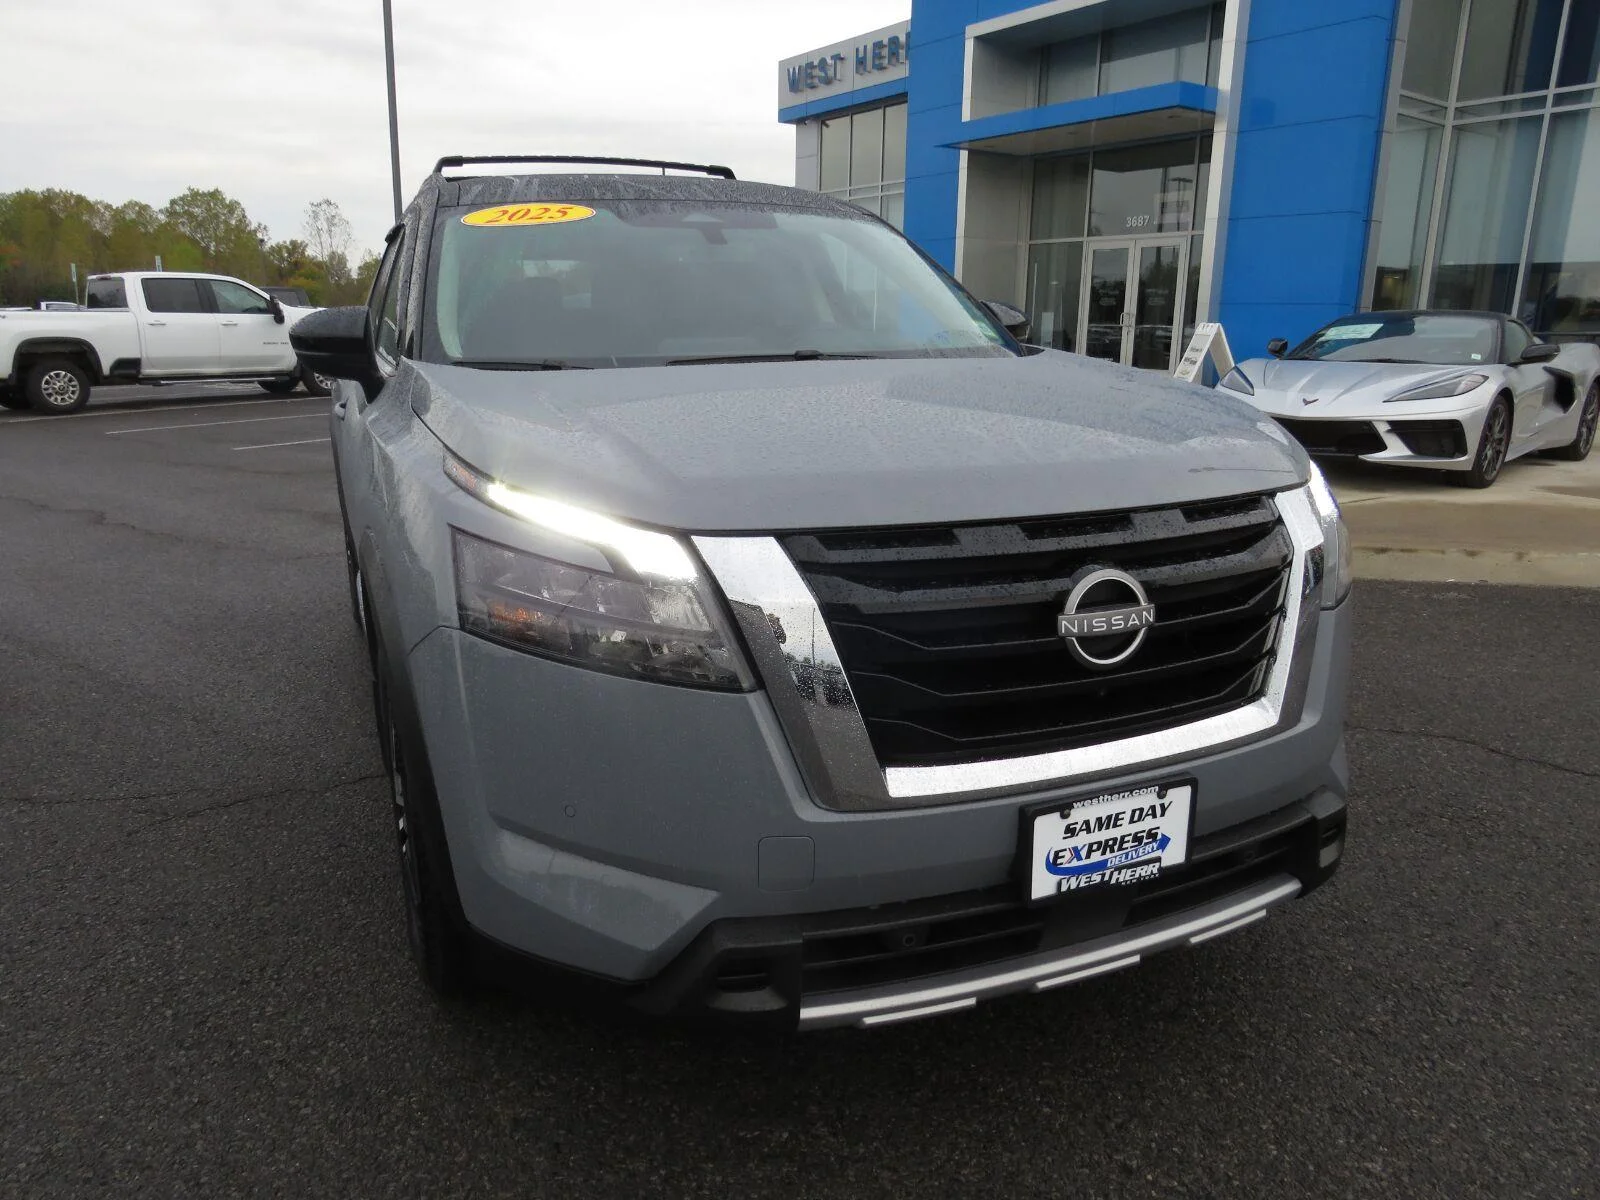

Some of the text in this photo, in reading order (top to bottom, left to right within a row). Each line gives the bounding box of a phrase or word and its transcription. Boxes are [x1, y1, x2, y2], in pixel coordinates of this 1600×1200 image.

[787, 53, 844, 93] WEST
[484, 206, 574, 224] 2025
[1126, 215, 1150, 227] 3687
[1061, 608, 1154, 634] NISSAN
[1072, 785, 1159, 809] westherr.com
[1062, 800, 1173, 840] SAME DAY
[1052, 826, 1160, 867] EXPRESS
[1107, 840, 1160, 868] DELIVERY
